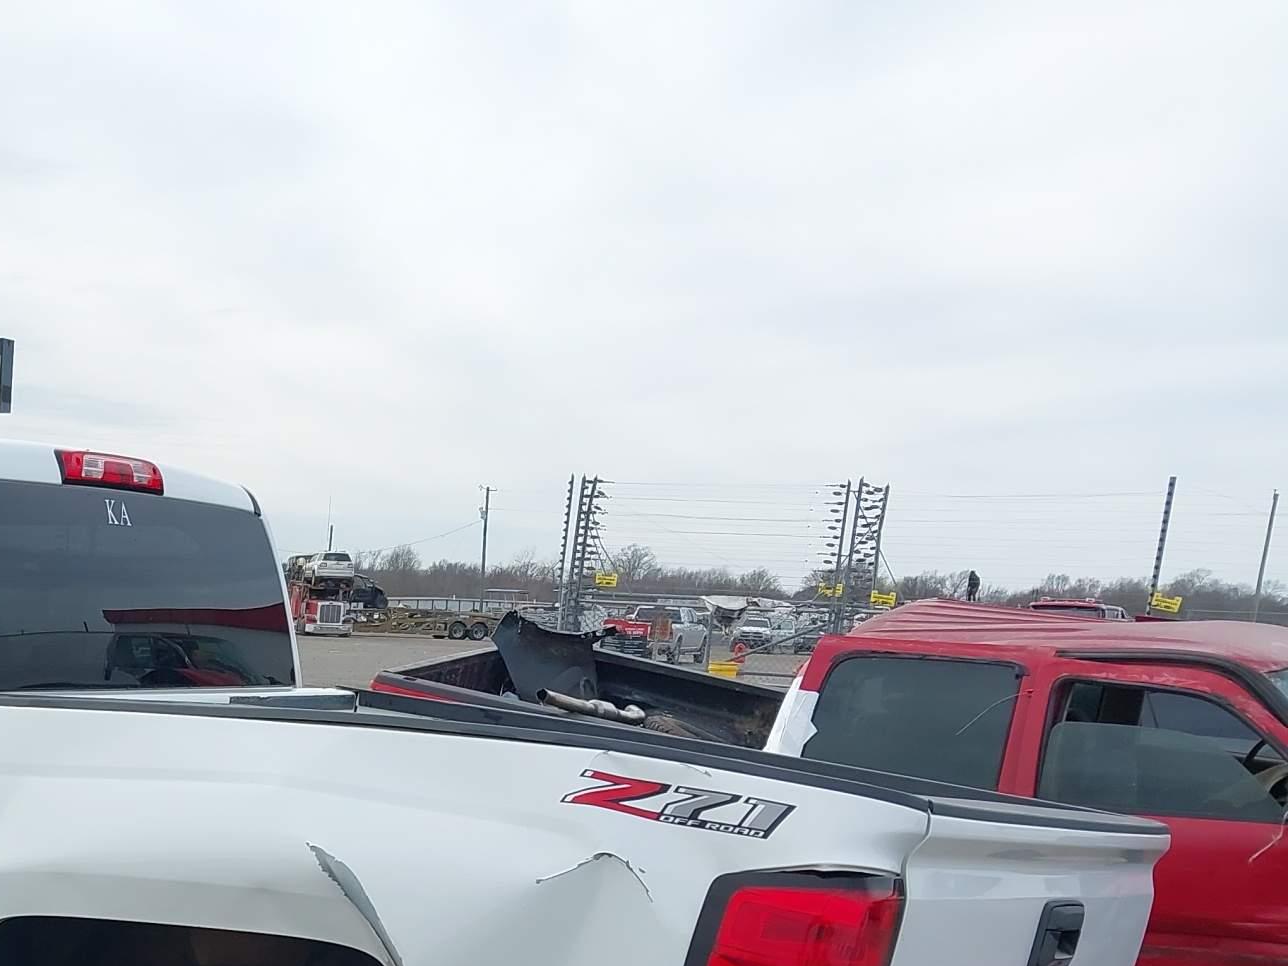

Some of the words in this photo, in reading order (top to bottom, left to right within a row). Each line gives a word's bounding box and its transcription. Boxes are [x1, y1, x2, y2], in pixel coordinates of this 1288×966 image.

[104, 499, 132, 526] KA
[560, 769, 797, 836] Z71
[659, 815, 700, 827] OFF
[705, 822, 765, 838] ROAD
